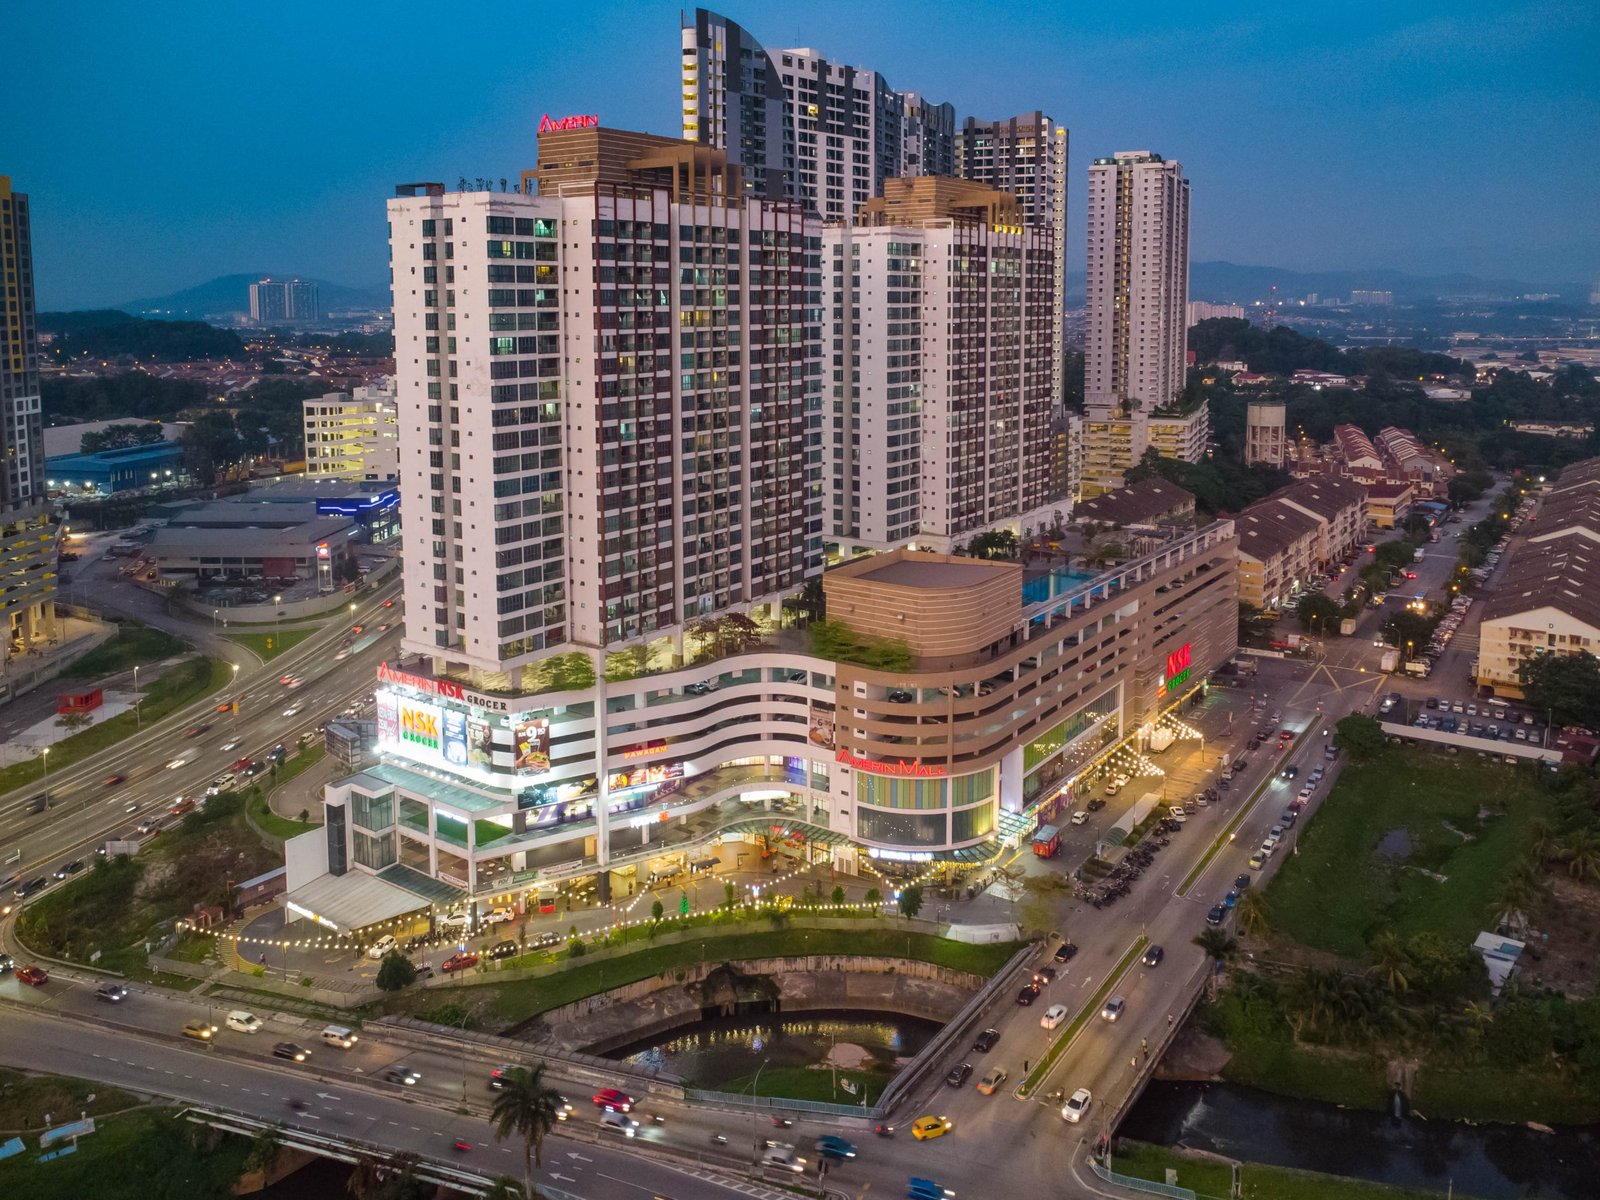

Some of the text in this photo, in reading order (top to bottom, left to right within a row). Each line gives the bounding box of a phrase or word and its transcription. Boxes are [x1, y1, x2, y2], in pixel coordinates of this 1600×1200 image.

[539, 113, 598, 132] AMERIN
[1167, 642, 1192, 679] NSK
[436, 678, 465, 700] NSK
[466, 694, 508, 711] GROCER
[402, 706, 439, 737] NSK
[402, 730, 439, 750] GROCER
[837, 748, 948, 776] AMERIN MALL
